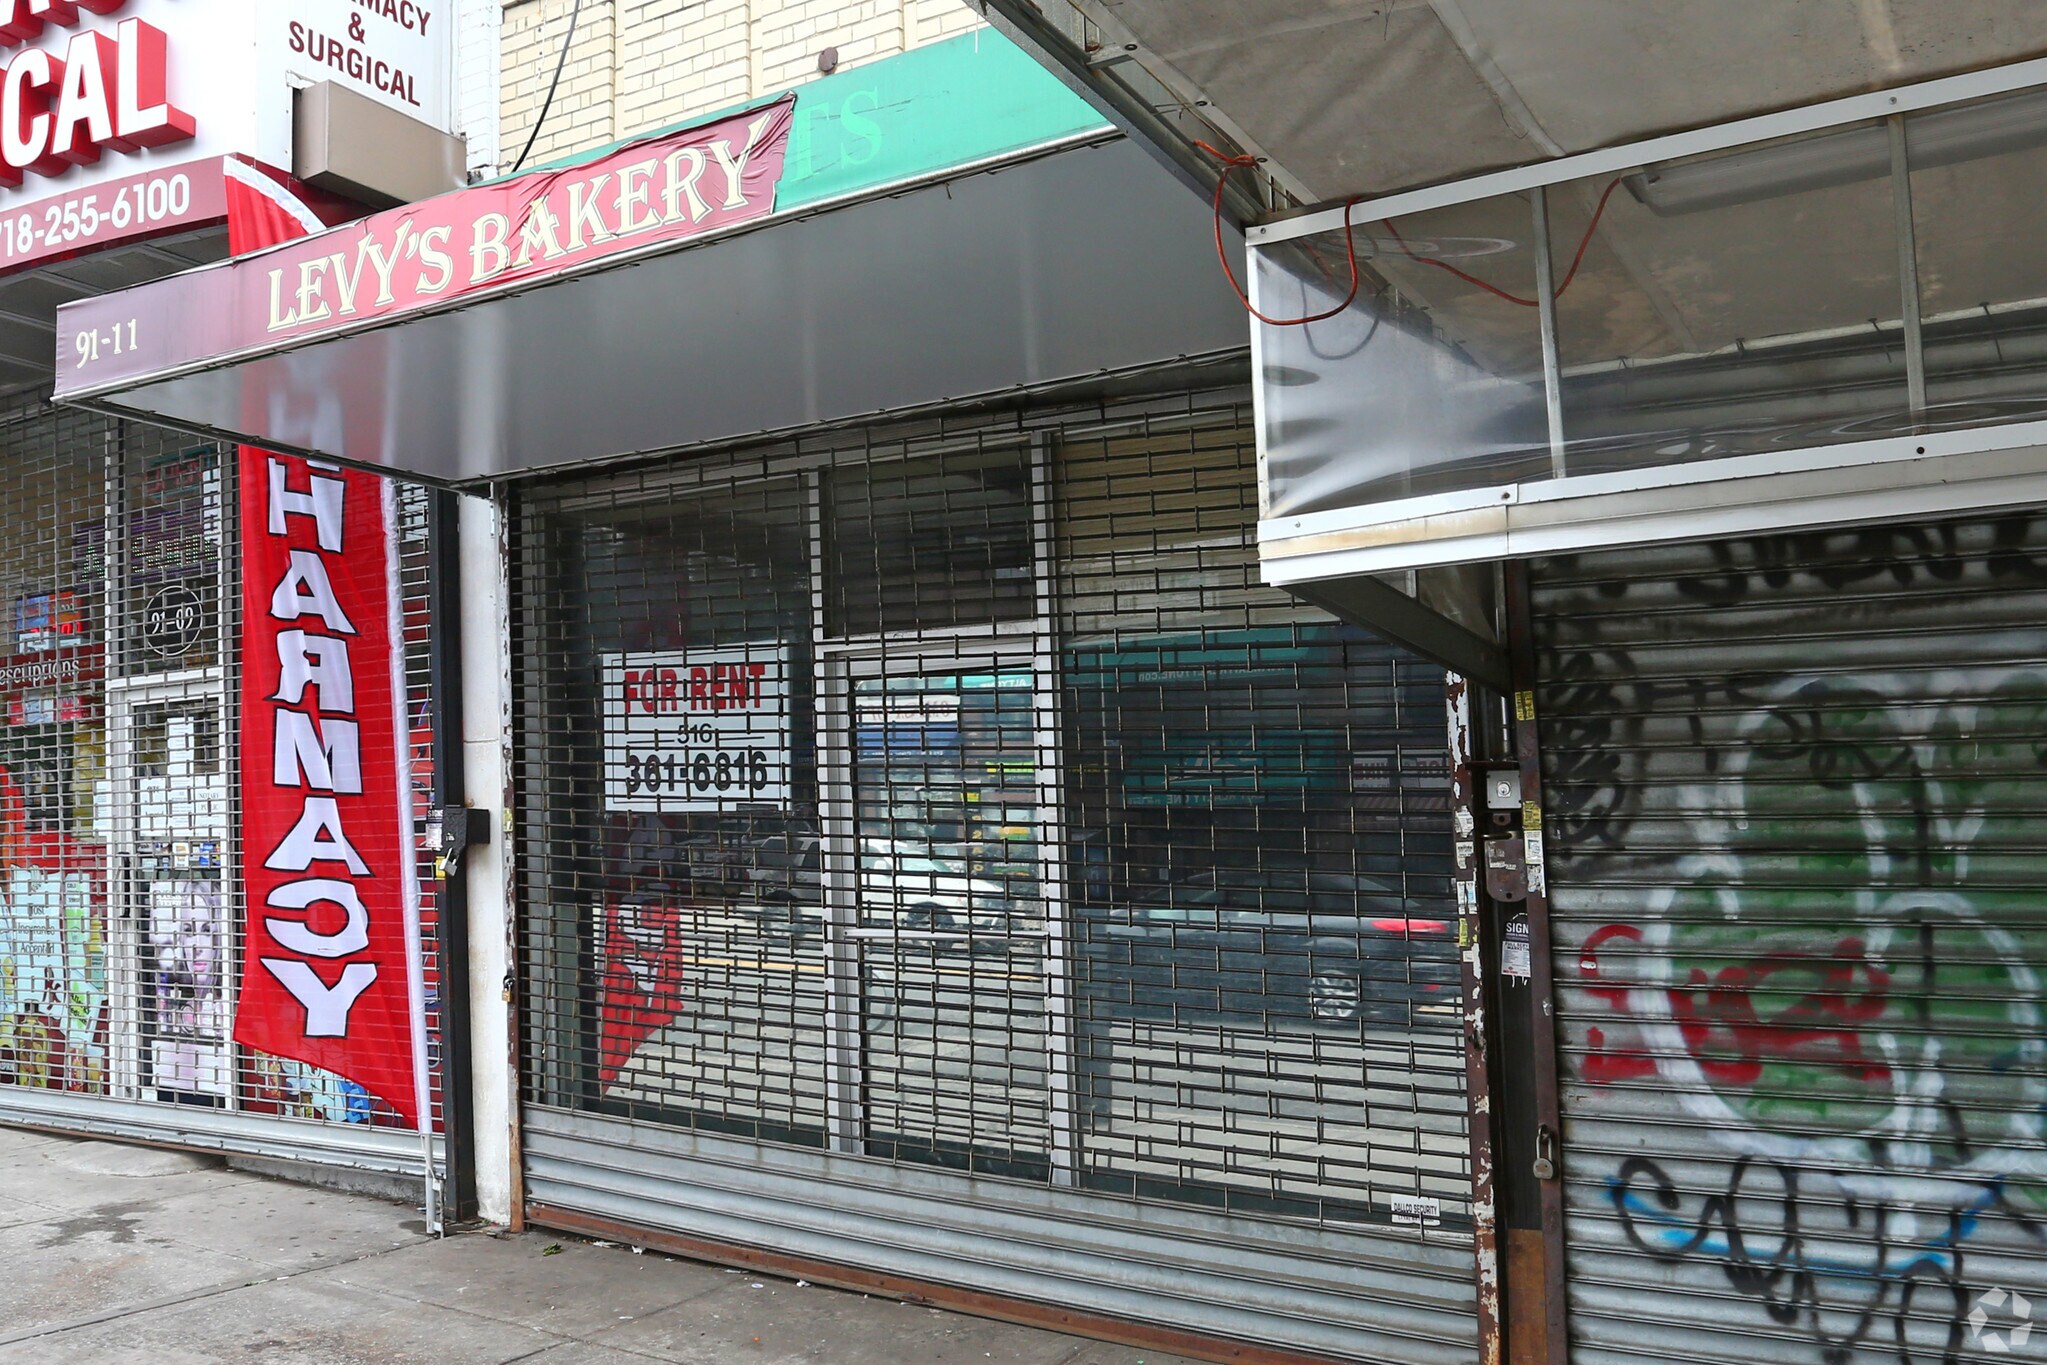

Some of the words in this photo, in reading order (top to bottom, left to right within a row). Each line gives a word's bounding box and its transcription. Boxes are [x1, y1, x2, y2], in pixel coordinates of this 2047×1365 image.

[348, 12, 365, 44] &
[289, 21, 421, 107] SURGICAL
[0, 173, 190, 257] 18-255-6100
[266, 218, 454, 333] LEVY'S
[468, 112, 772, 284] BAKERY
[76, 318, 138, 369] 91-11
[151, 607, 193, 634] 91-09
[624, 669, 678, 714] FOR
[690, 663, 765, 711] RENT
[677, 723, 712, 744] 516
[627, 750, 768, 793] 361-6816
